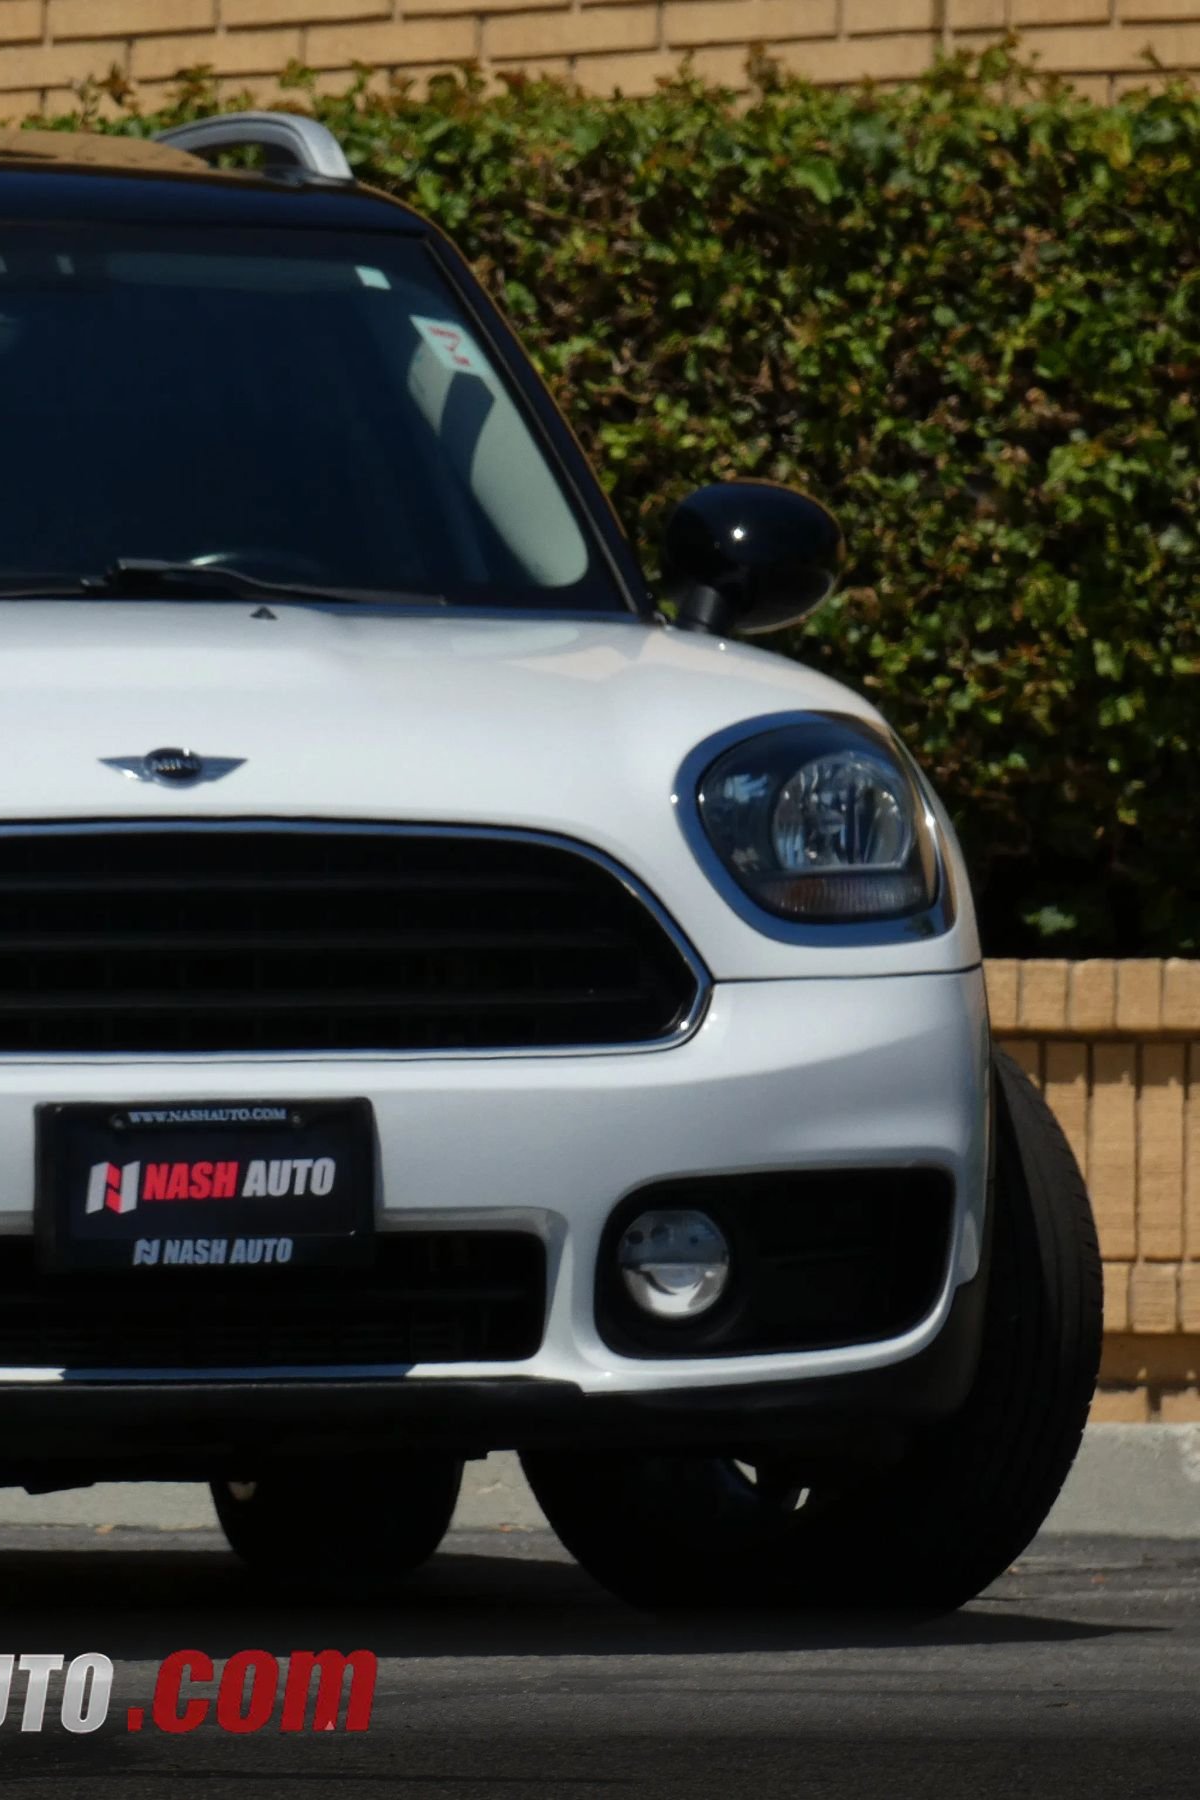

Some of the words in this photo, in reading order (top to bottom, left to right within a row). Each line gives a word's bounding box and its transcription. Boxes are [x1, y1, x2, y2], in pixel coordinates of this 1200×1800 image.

[128, 1109, 287, 1123] WWW.NASHAUTO.COM
[143, 1161, 238, 1200] NASH
[241, 1157, 337, 1198] AUTO
[163, 1239, 230, 1264] NASH
[229, 1238, 293, 1264] AUTO
